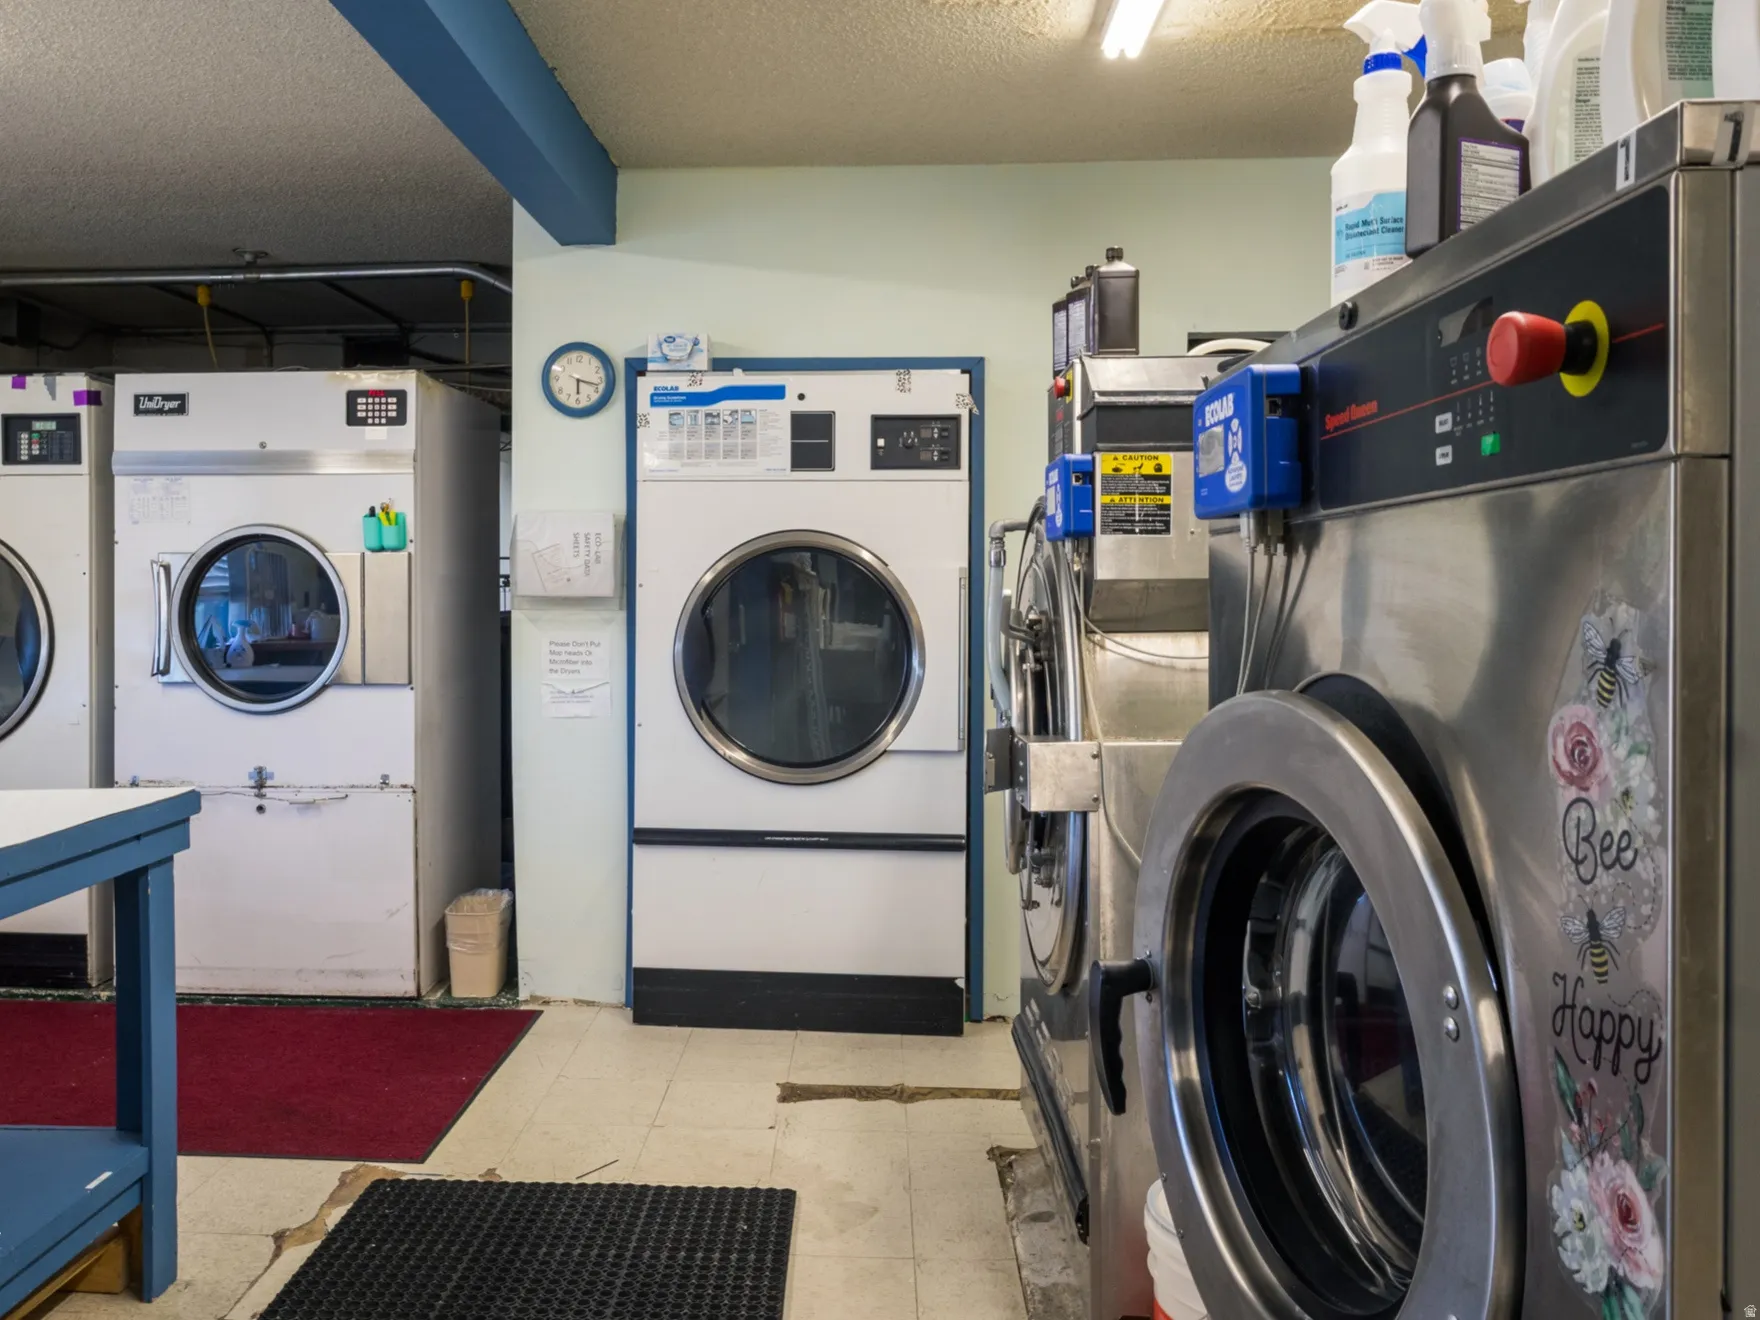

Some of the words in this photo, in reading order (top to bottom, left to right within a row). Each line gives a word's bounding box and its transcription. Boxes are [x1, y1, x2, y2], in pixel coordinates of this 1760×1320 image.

[1380, 216, 1403, 224] Surface
[1380, 226, 1404, 234] Cleaner
[567, 357, 573, 365] 11
[576, 355, 584, 363] 12
[588, 358, 592, 366] 1
[594, 365, 601, 374] 2
[554, 374, 560, 382] 9
[598, 376, 604, 385] 3
[558, 386, 564, 395] 8
[593, 386, 599, 394] 4
[566, 393, 572, 401] 7
[575, 396, 581, 405] 6
[586, 394, 592, 402] 5
[139, 396, 181, 411] UniDryer
[1204, 392, 1235, 428] ECOLAB
[1325, 406, 1349, 432] Speed
[1351, 400, 1378, 421] Queen
[1562, 797, 1638, 885] Bee
[1552, 971, 1663, 1085] Happy
